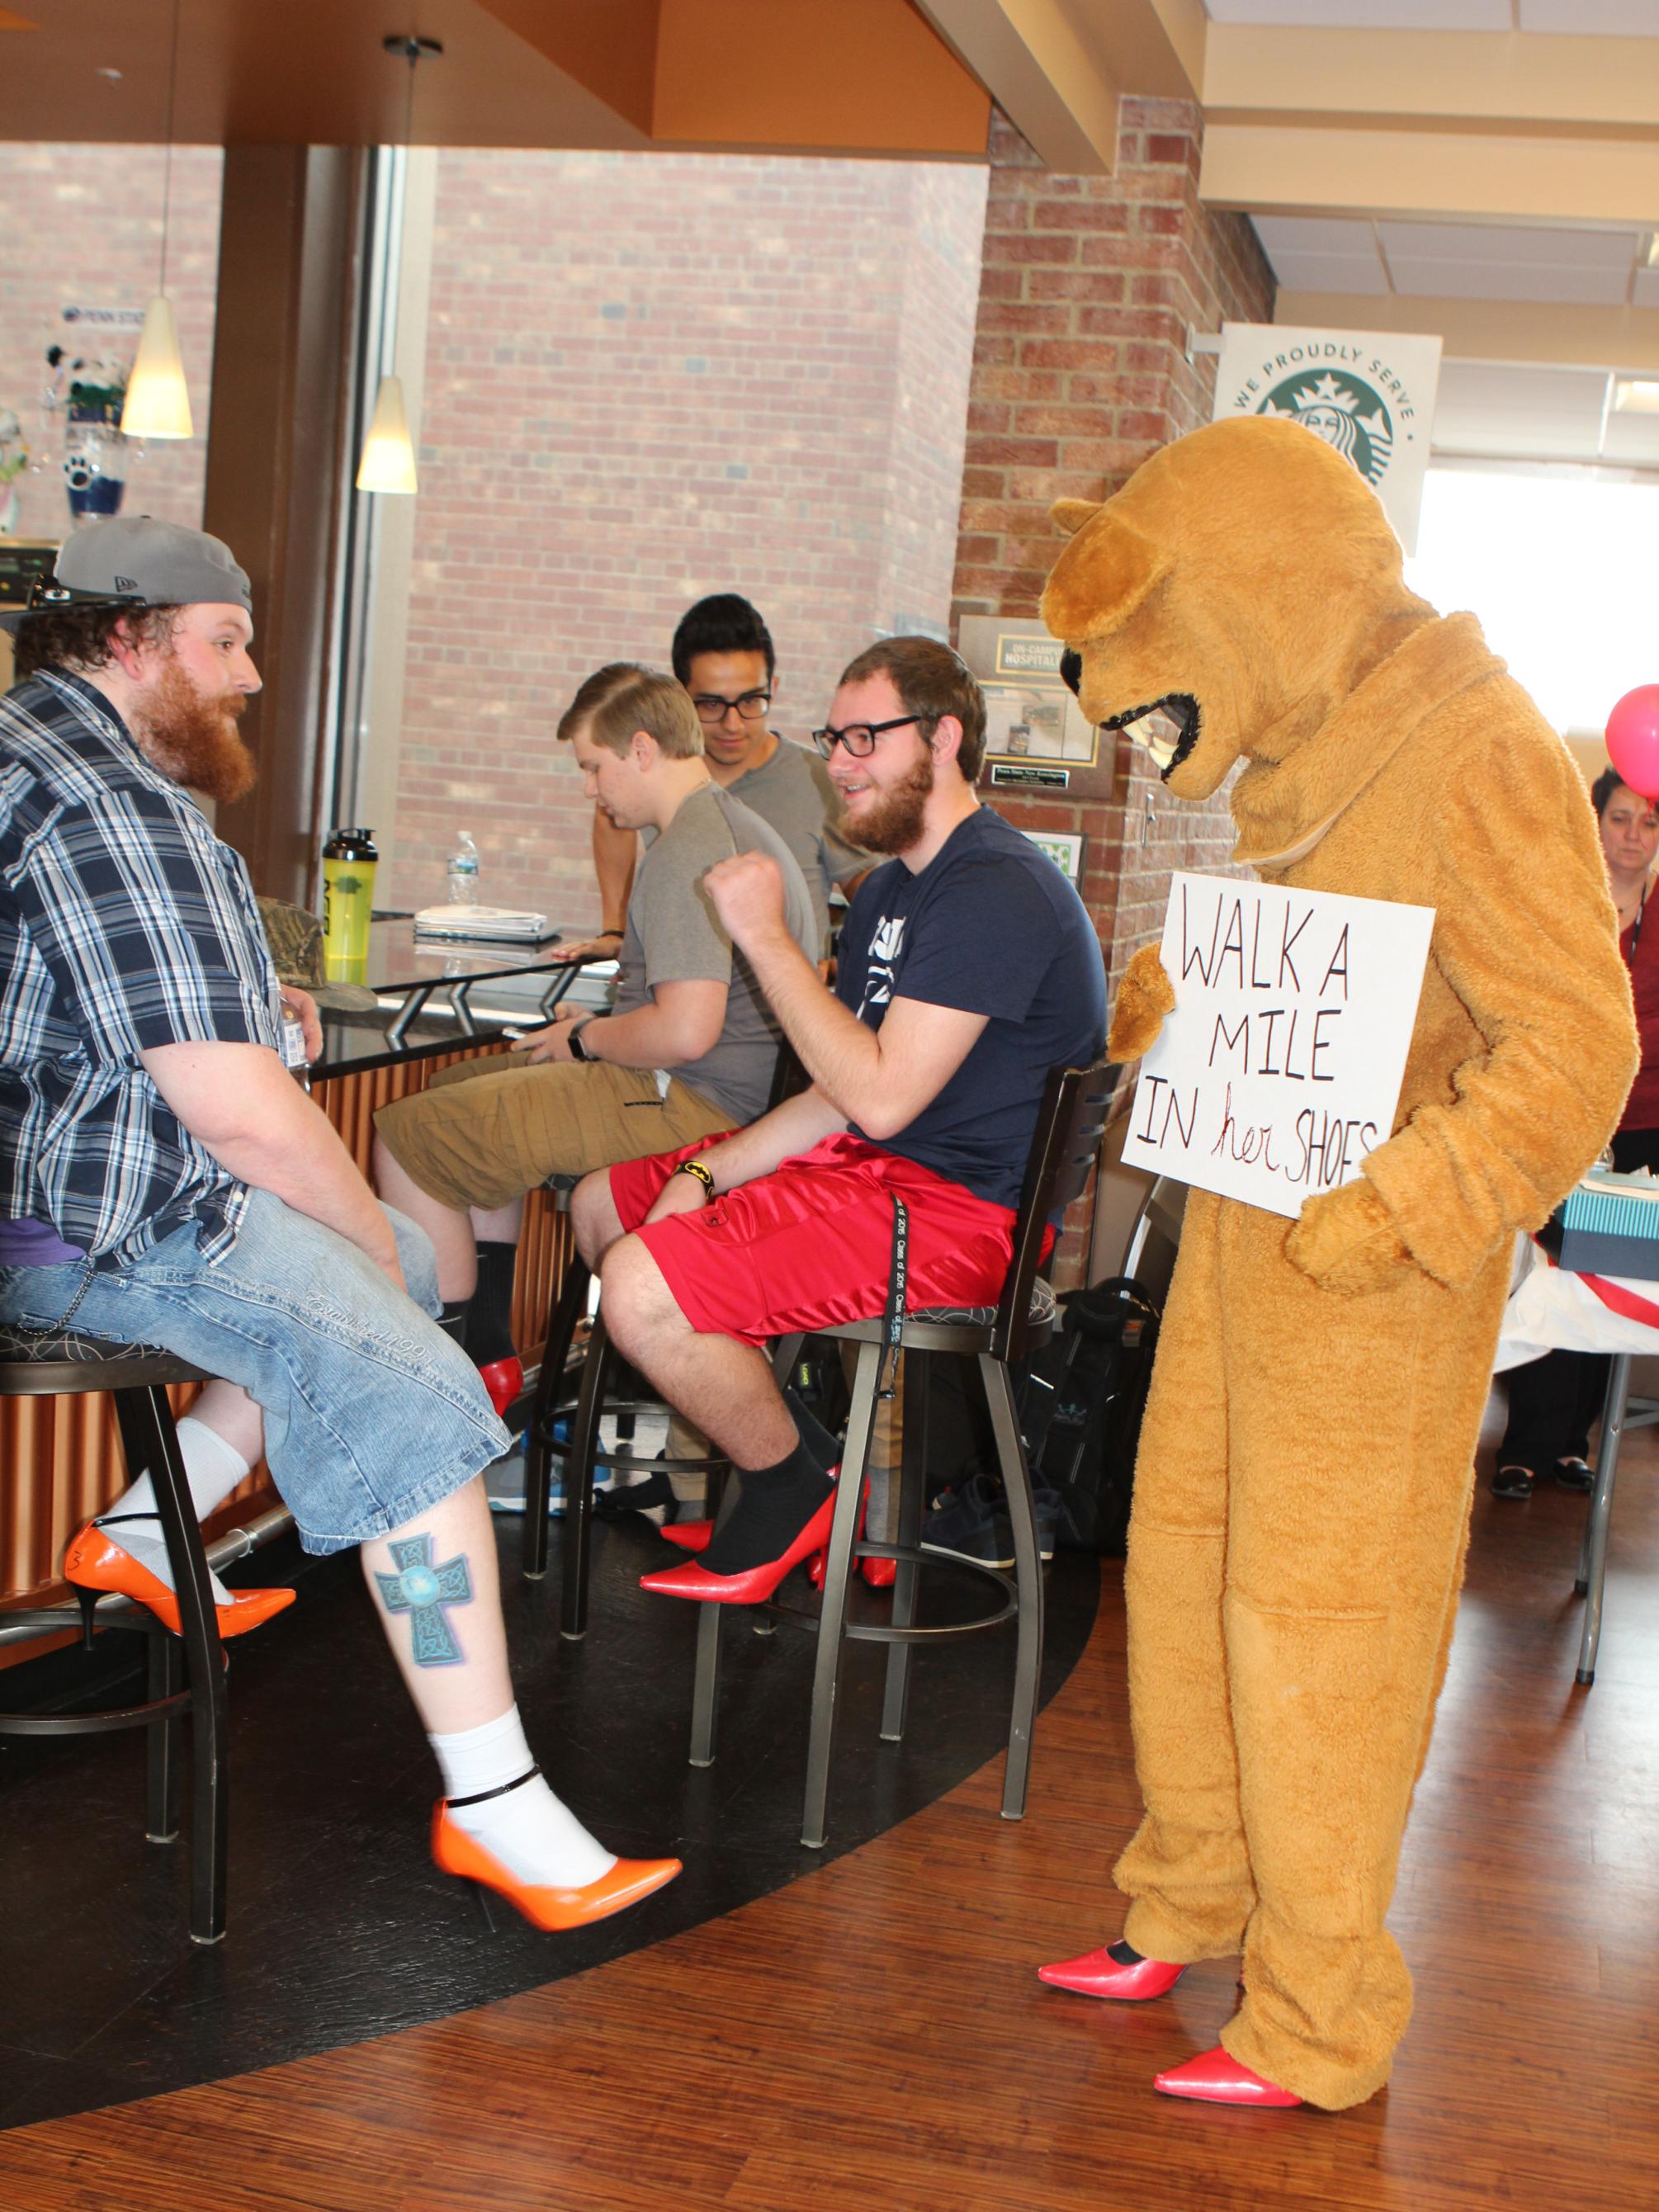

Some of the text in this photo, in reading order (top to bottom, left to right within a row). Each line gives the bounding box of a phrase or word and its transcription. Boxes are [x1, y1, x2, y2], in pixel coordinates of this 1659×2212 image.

[1233, 343, 1415, 420] WE PROUDLY SERVE
[1182, 883, 1349, 1001] WALK A
[1208, 1009, 1343, 1081] MILE
[1137, 1075, 1198, 1150] IN
[1211, 1081, 1279, 1172] her
[896, 1240, 906, 1260] Class
